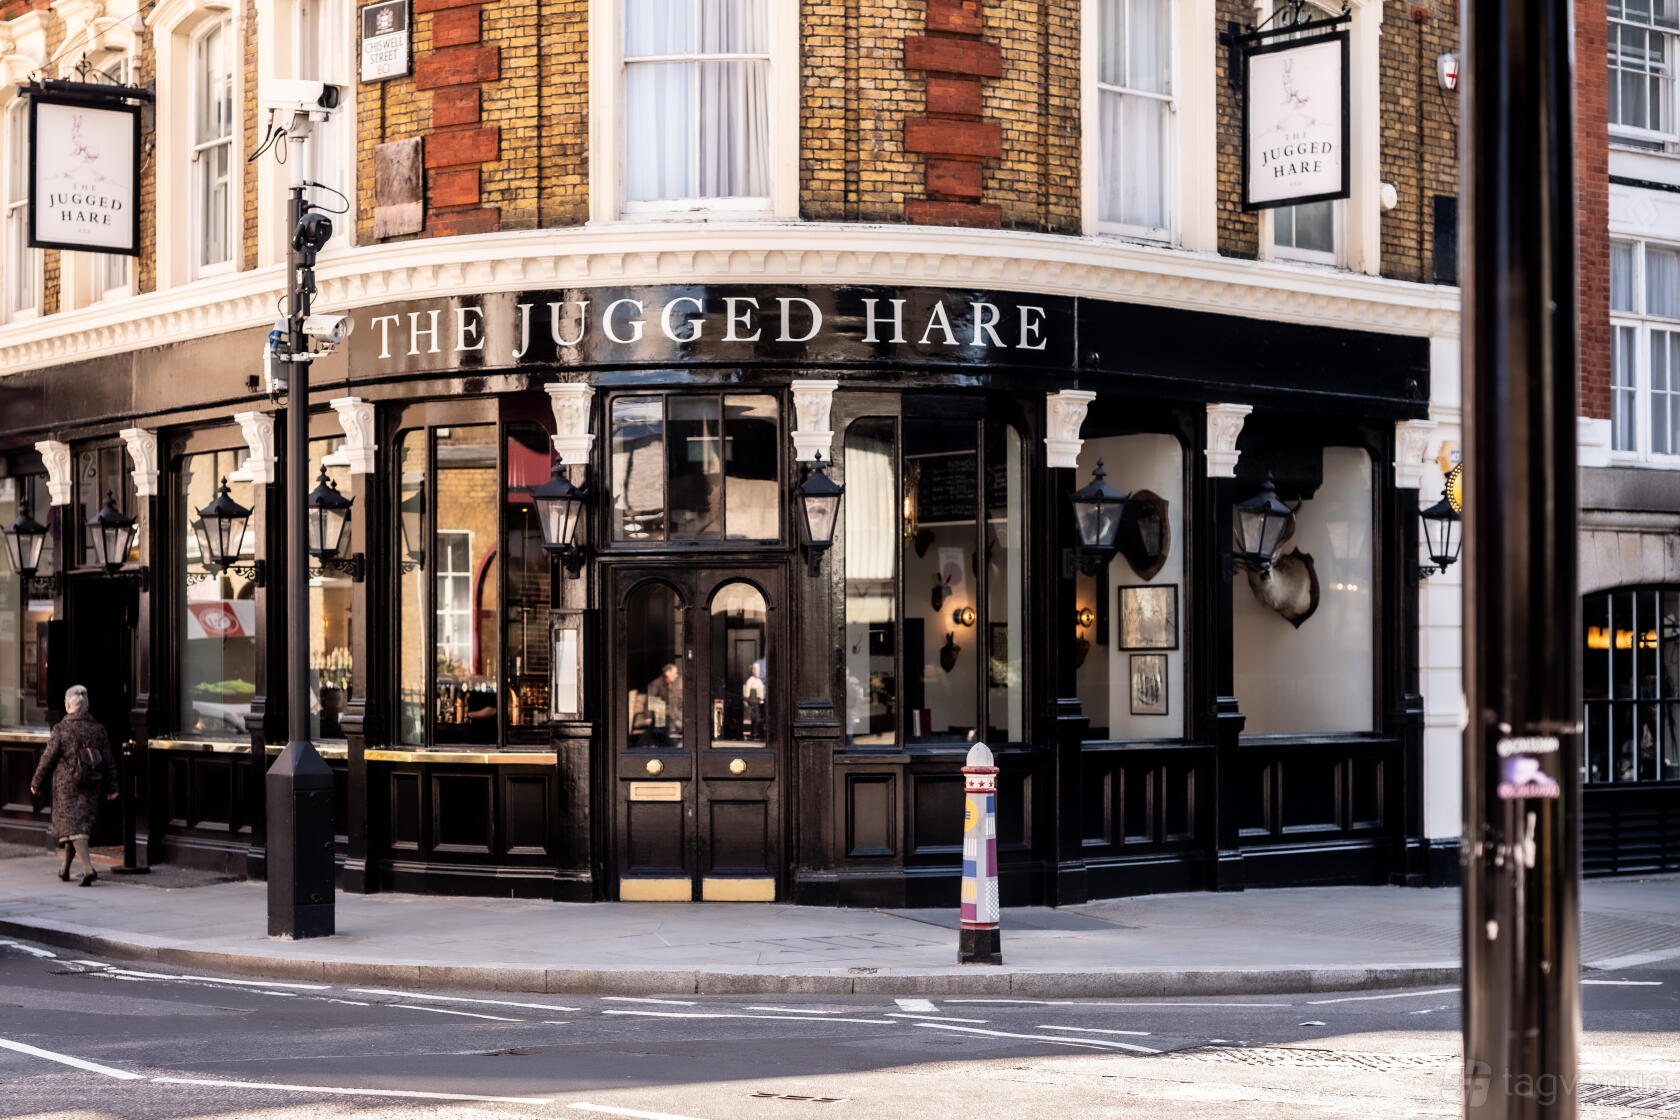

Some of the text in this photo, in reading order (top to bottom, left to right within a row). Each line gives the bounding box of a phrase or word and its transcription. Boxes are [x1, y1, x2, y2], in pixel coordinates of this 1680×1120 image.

[364, 36, 404, 54] CHISWELL
[370, 48, 398, 65] STREET
[1284, 131, 1307, 141] THE
[1261, 141, 1332, 168] JUGGED
[1273, 160, 1322, 178] HARE
[72, 183, 96, 192] THE
[48, 193, 123, 211] JUGGED
[61, 210, 112, 226] HARE
[370, 297, 1047, 359] THE JUGGED HARE
